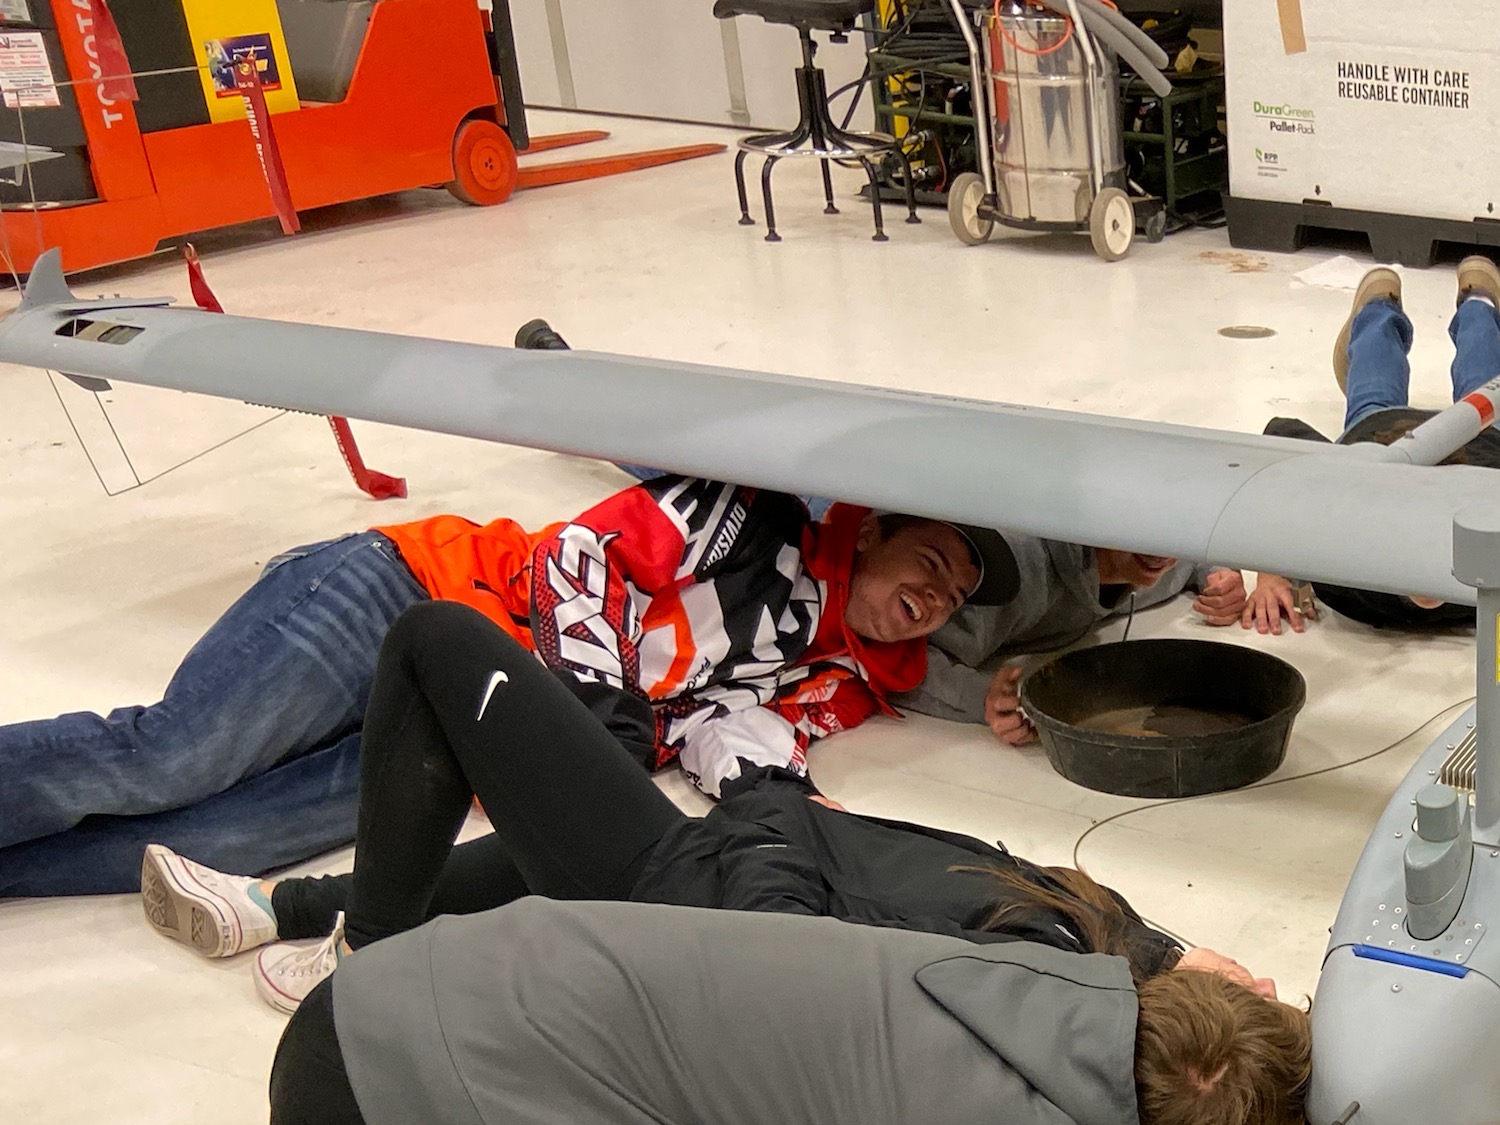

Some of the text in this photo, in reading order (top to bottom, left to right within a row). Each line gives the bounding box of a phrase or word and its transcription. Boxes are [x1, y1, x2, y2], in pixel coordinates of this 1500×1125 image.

[1338, 61, 1470, 89] HANDLE WITH CARE
[1338, 81, 1469, 109] REUSABLE CONTAINER
